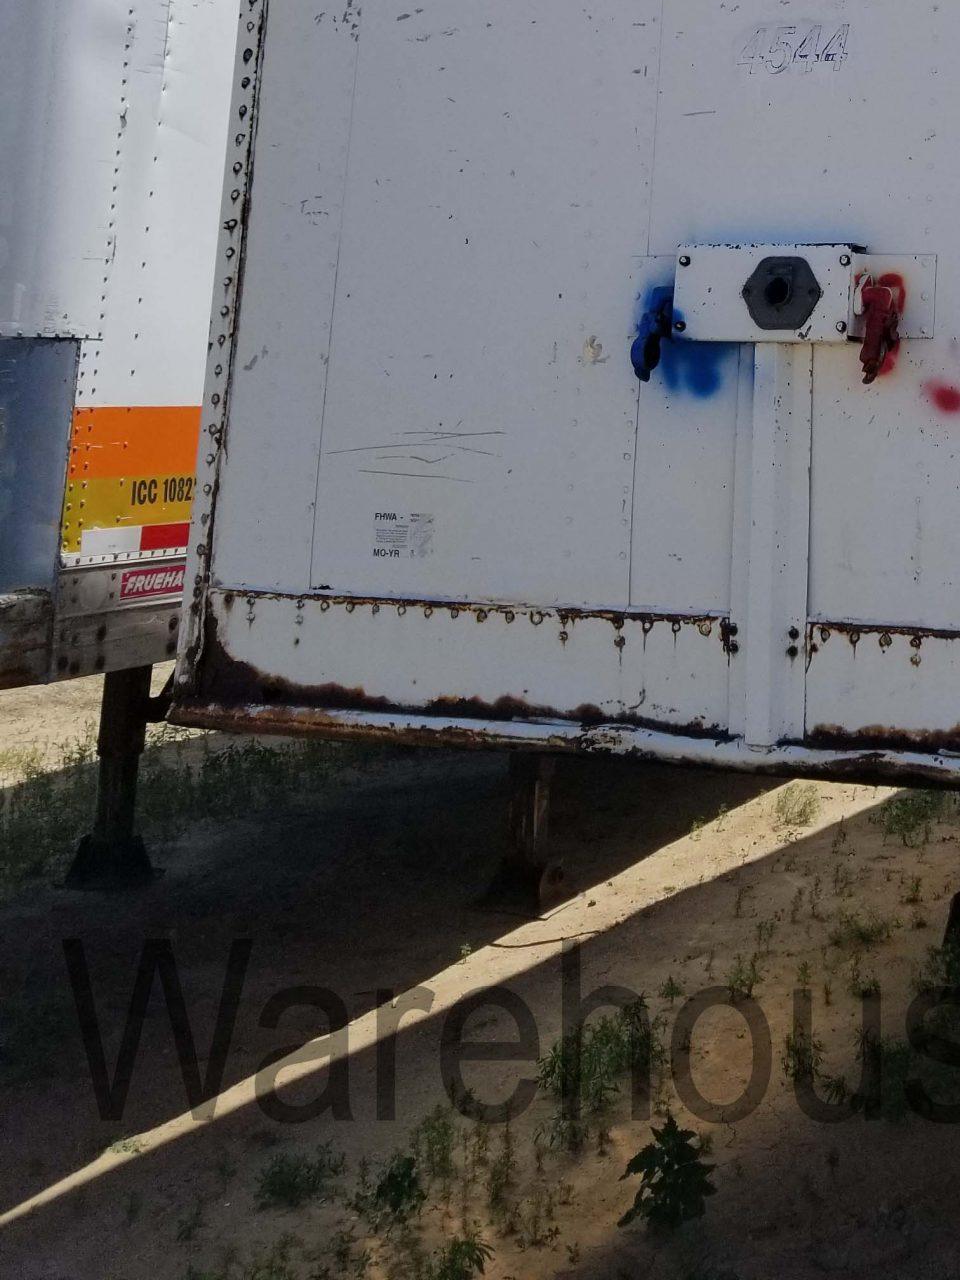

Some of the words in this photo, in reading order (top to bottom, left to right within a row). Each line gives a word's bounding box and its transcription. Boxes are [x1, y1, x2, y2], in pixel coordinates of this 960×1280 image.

[130, 478, 158, 506] ICC
[374, 512, 398, 521] FHWA
[373, 548, 400, 558] MO-YR
